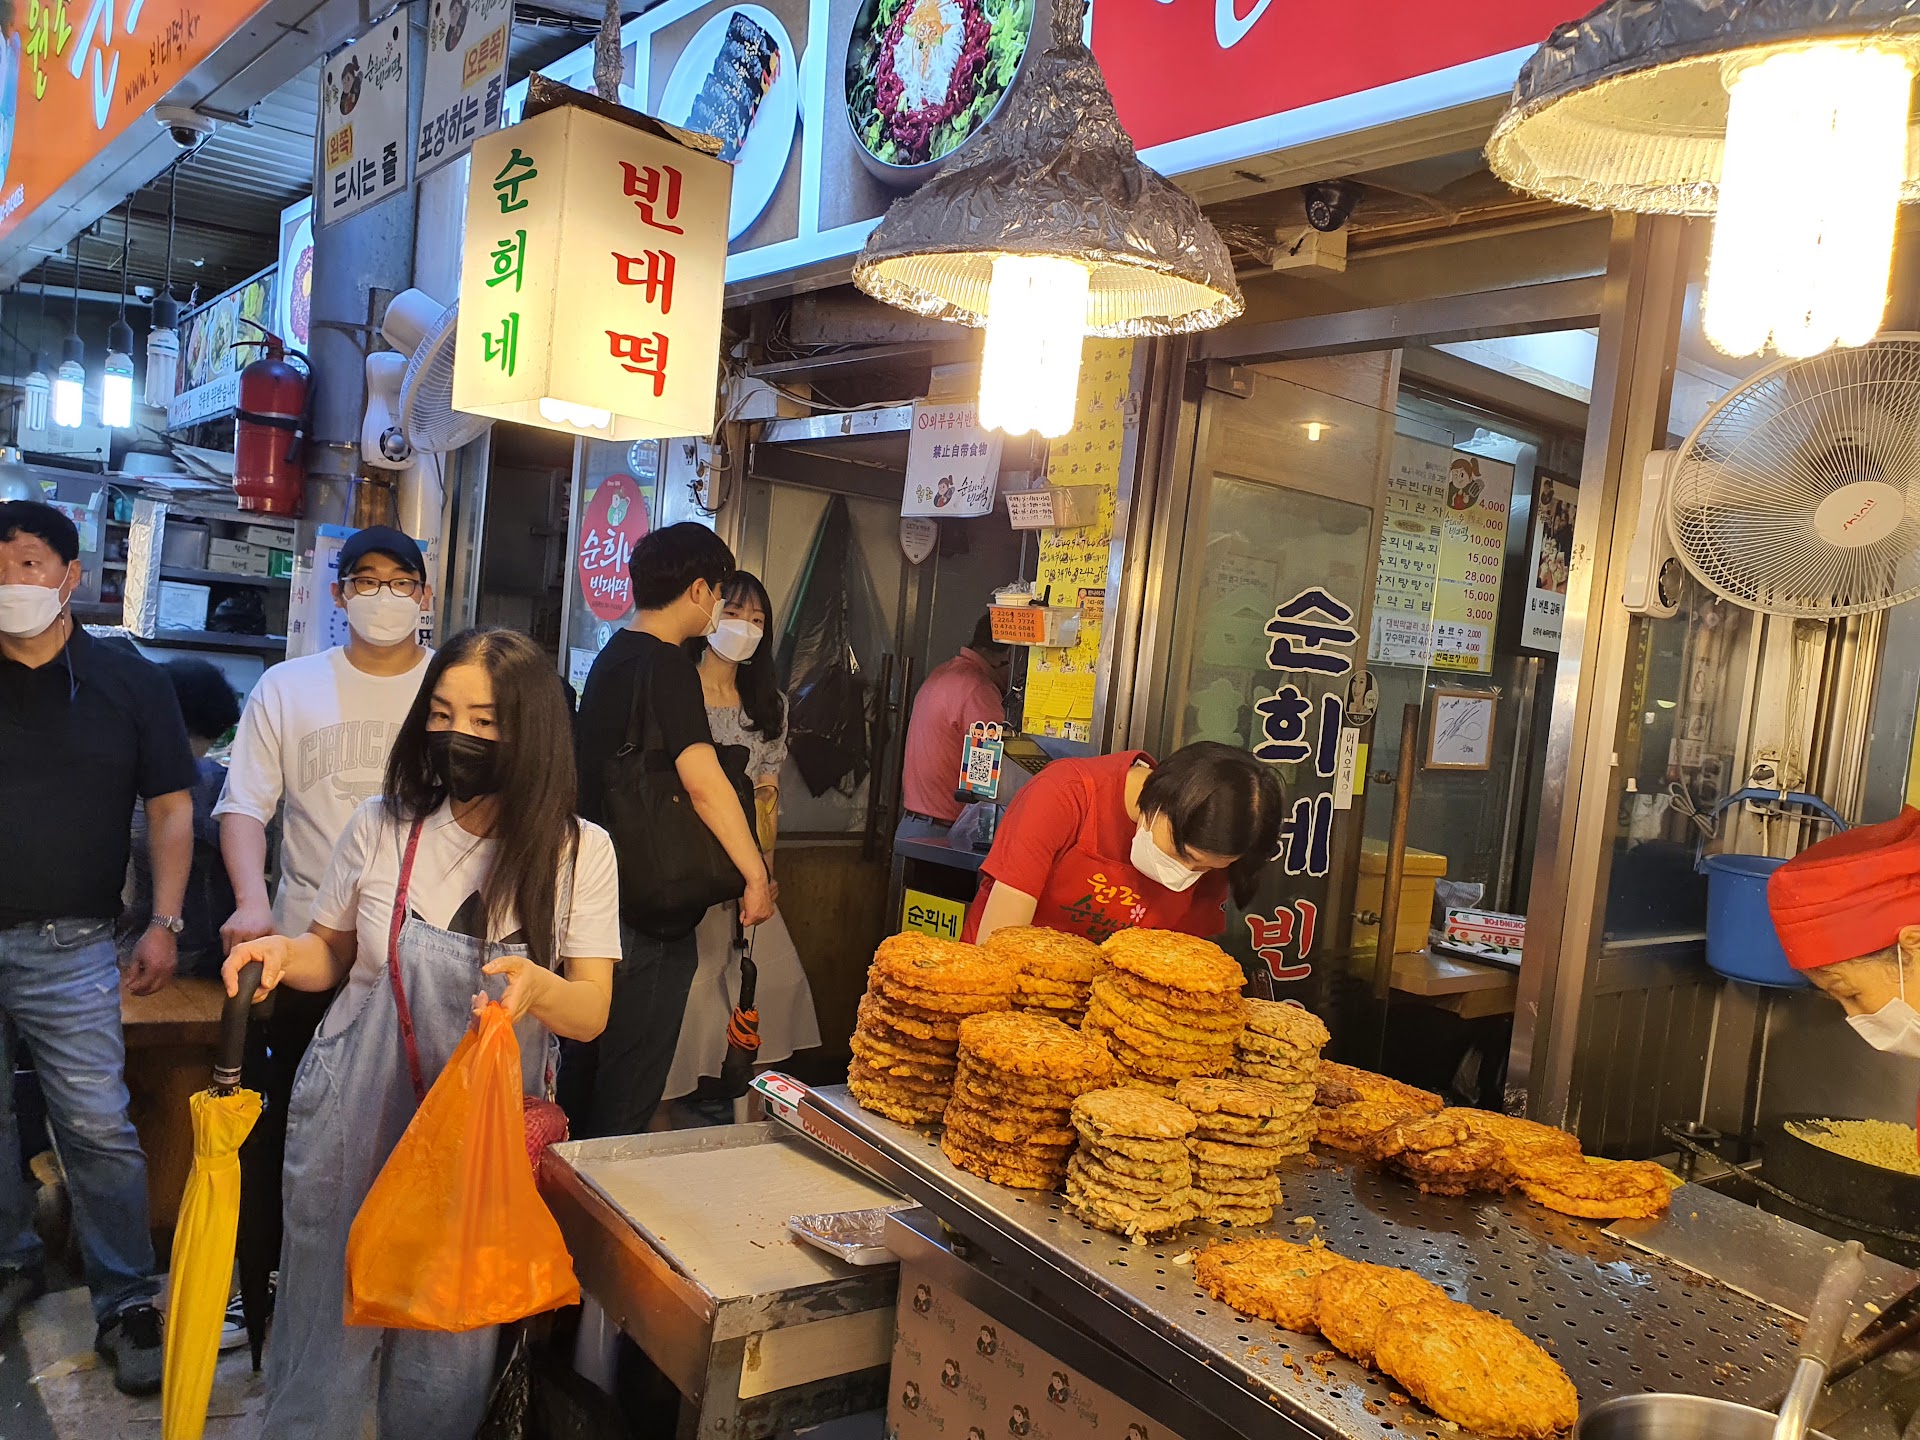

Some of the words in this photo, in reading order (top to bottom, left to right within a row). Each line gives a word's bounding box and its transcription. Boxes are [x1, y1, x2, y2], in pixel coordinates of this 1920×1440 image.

[462, 24, 507, 86] (오른쪽)
[418, 95, 479, 163] 포장하는
[483, 74, 502, 128] 줄
[326, 124, 354, 165] (왼쪽)
[333, 158, 378, 208] 드시는
[381, 141, 398, 187] 줄
[480, 147, 539, 378] 순희네
[604, 160, 684, 398] 빈대떡
[933, 441, 988, 458] 禁止自带食物
[1479, 500, 1506, 513] 4,000
[1470, 534, 1501, 549] 10,000
[1468, 553, 1499, 567] 15,000
[1465, 571, 1497, 585] 28,000
[590, 574, 630, 602] 빈대떡
[1463, 589, 1495, 602] 15,000
[1466, 608, 1493, 620] 3,000
[1467, 629, 1482, 639] 2,000
[1465, 644, 1480, 652] 4,000
[1461, 656, 1479, 665] 10,000
[1086, 872, 1141, 906] 원조
[907, 903, 958, 937] 순희네
